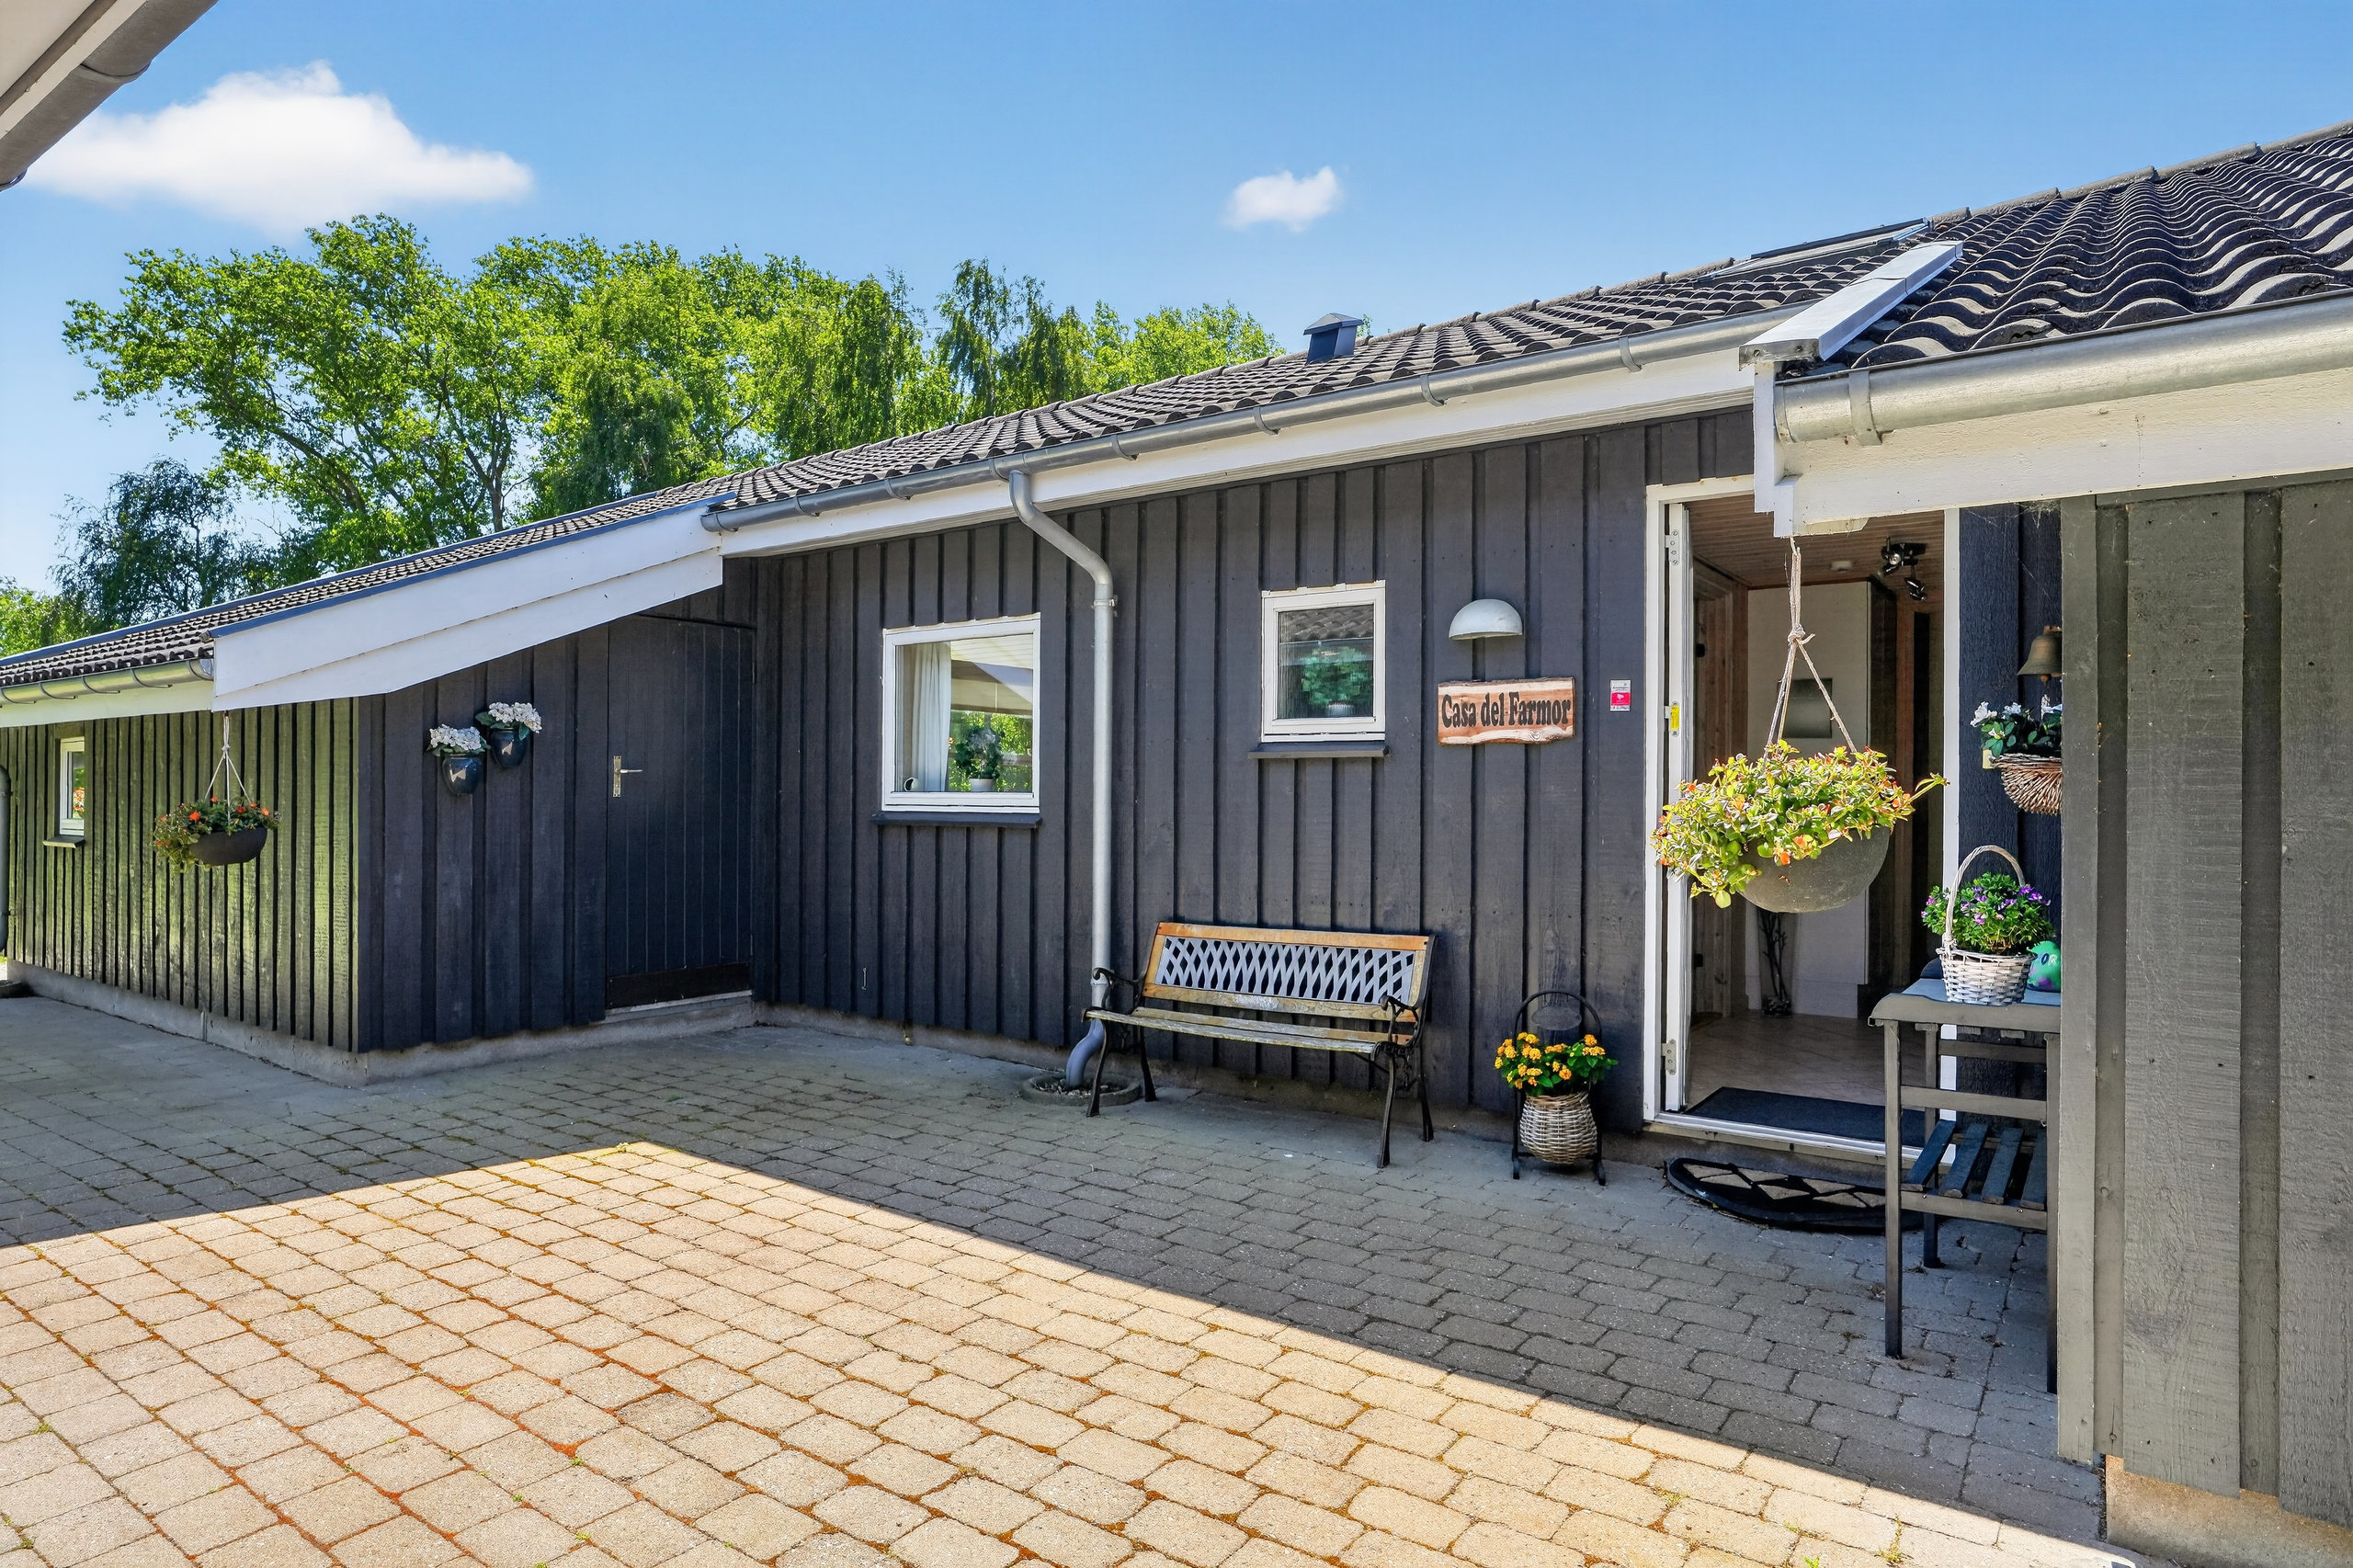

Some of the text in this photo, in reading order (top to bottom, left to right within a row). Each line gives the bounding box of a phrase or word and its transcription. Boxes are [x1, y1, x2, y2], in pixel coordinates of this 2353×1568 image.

[1441, 691, 1571, 728] Casa del Farmor
